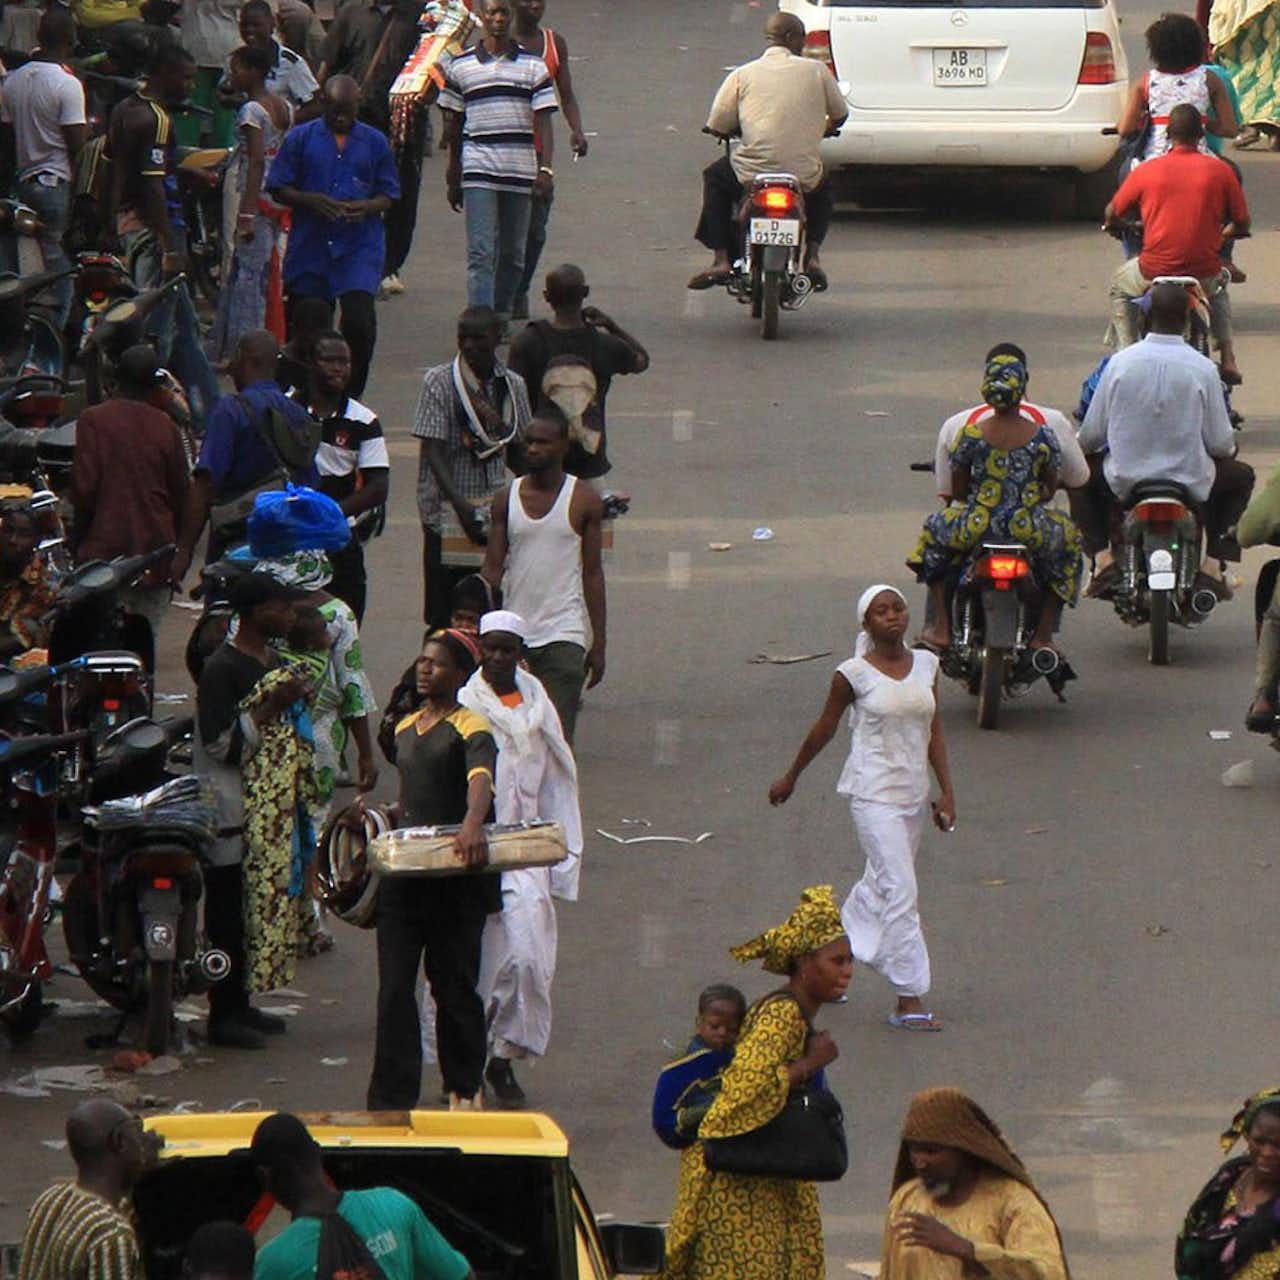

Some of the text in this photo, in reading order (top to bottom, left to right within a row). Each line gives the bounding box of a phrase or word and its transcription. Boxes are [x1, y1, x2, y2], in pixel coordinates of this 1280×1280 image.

[950, 50, 968, 67] AB
[937, 67, 984, 79] 3696 MD
